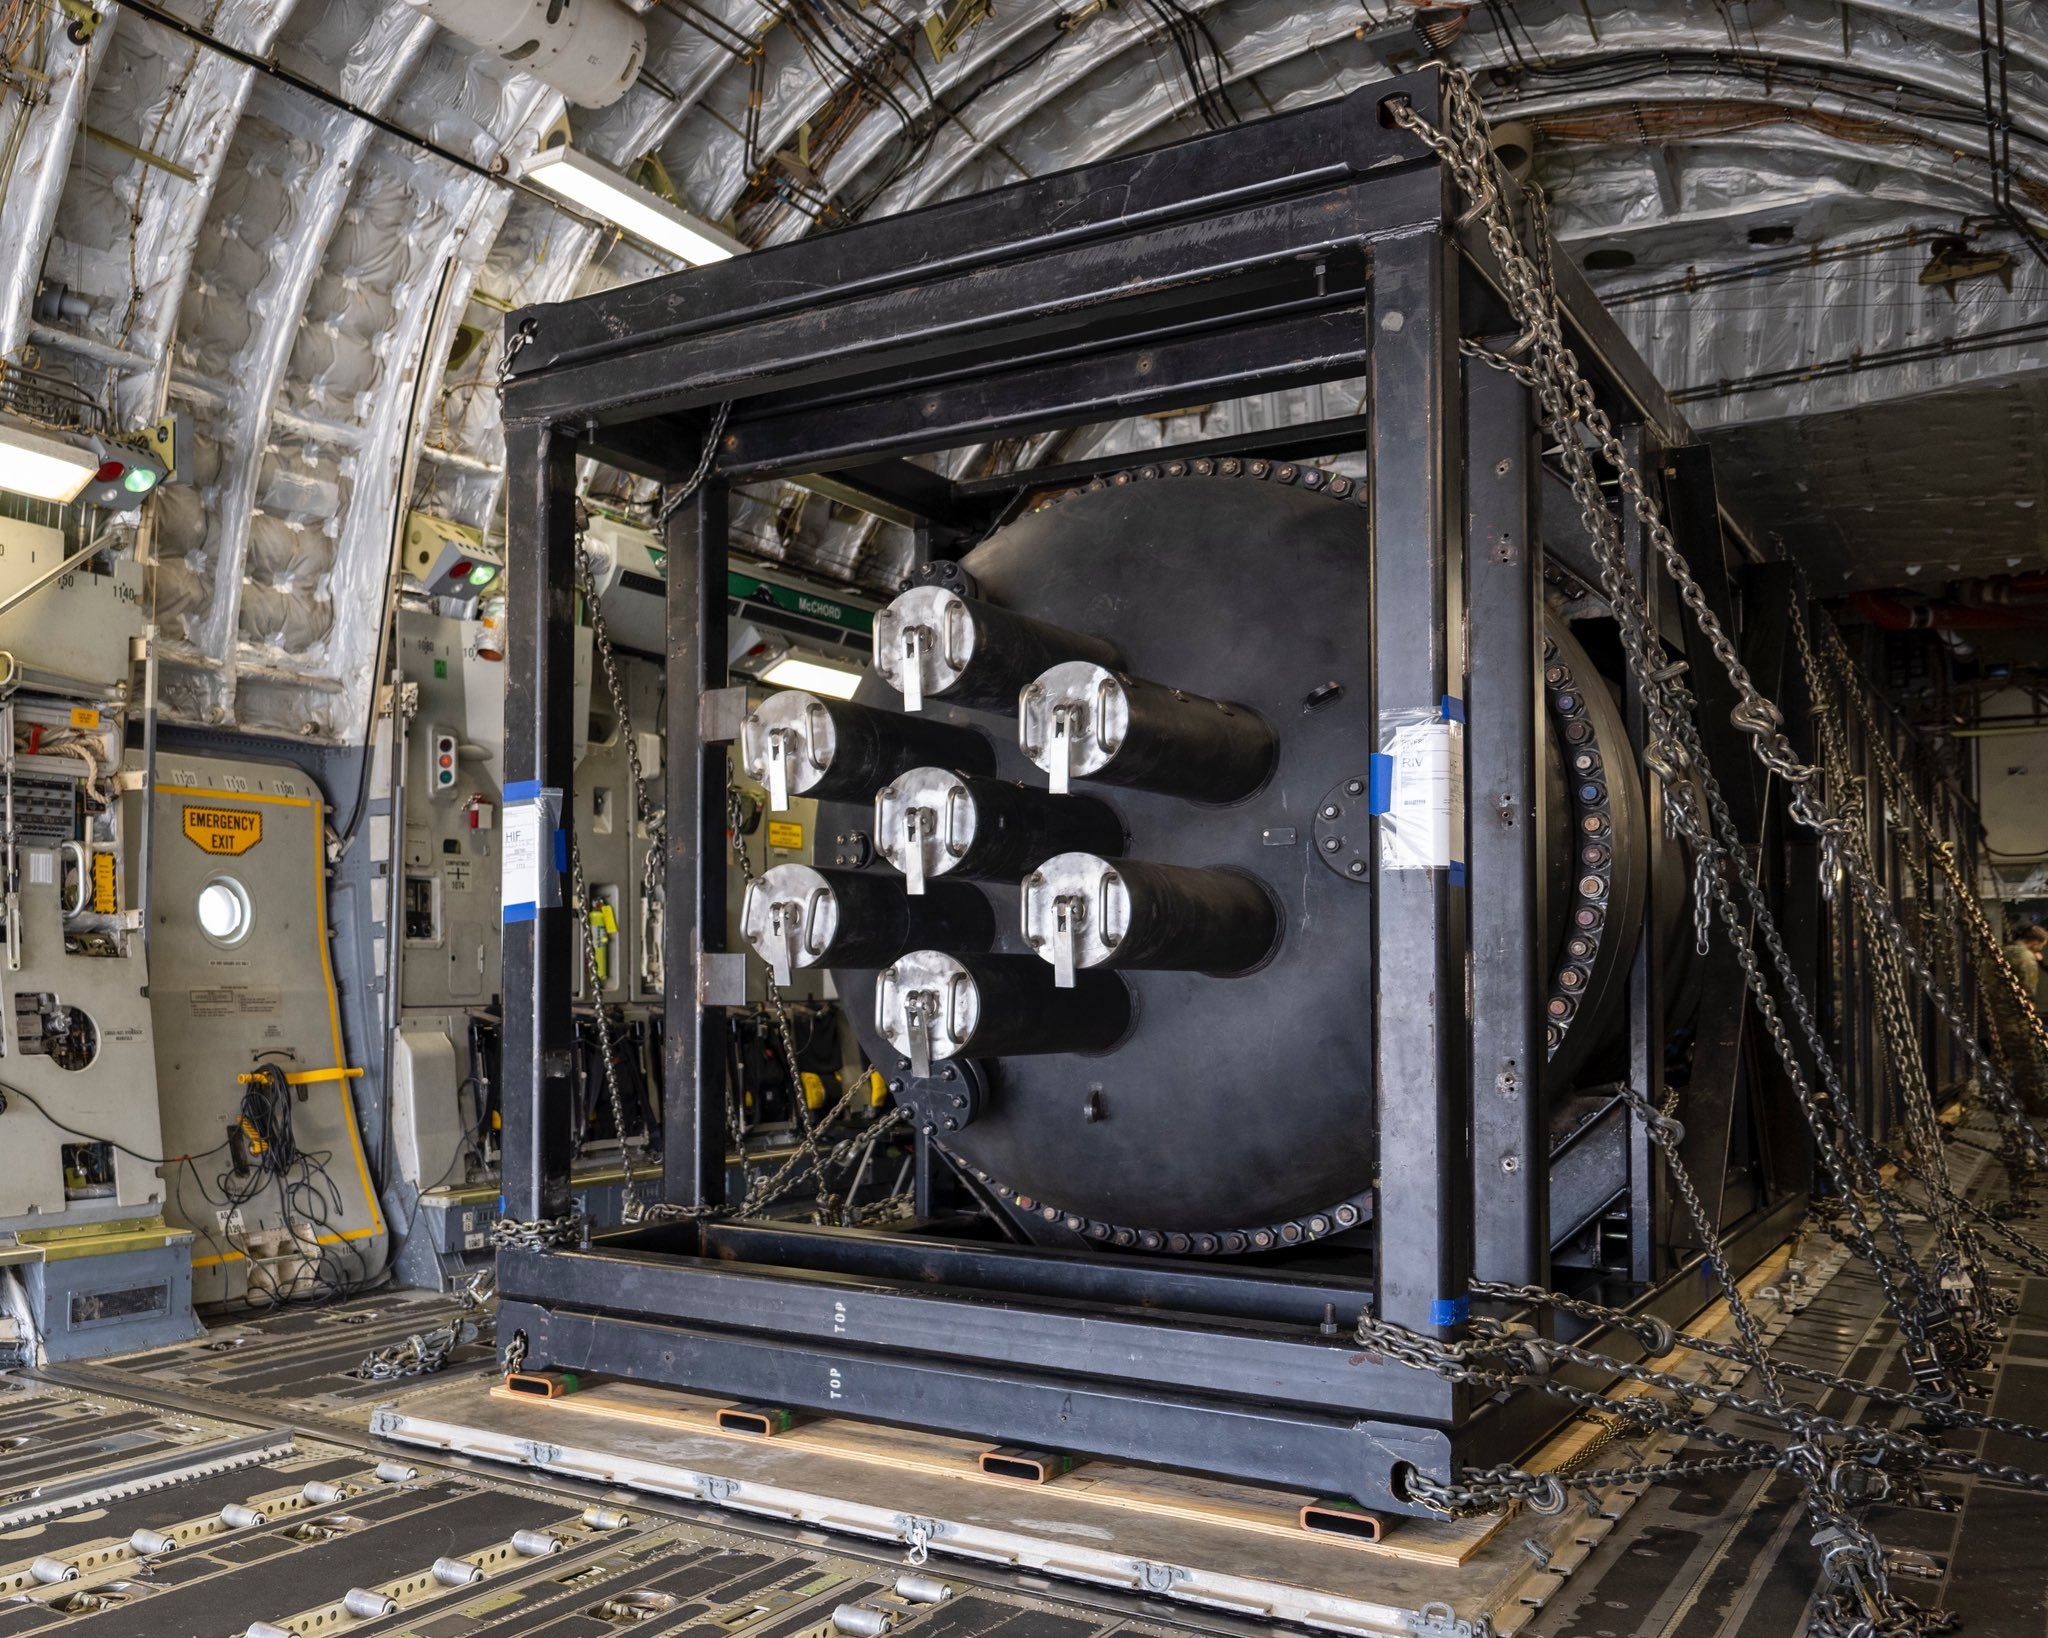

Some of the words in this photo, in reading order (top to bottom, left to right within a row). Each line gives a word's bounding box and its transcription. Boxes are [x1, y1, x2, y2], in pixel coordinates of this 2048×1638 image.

[113, 586, 135, 601] 1140
[799, 598, 841, 619] McCHORD
[1402, 757, 1423, 768] RIV
[174, 773, 195, 786] 1120
[226, 779, 246, 790] 1110
[275, 783, 294, 796] 1100
[190, 811, 255, 831] EMERGENCY
[211, 834, 235, 849] EXIT
[505, 831, 521, 842] HIF
[834, 1302, 846, 1333] TOP
[830, 1368, 842, 1399] TOP
